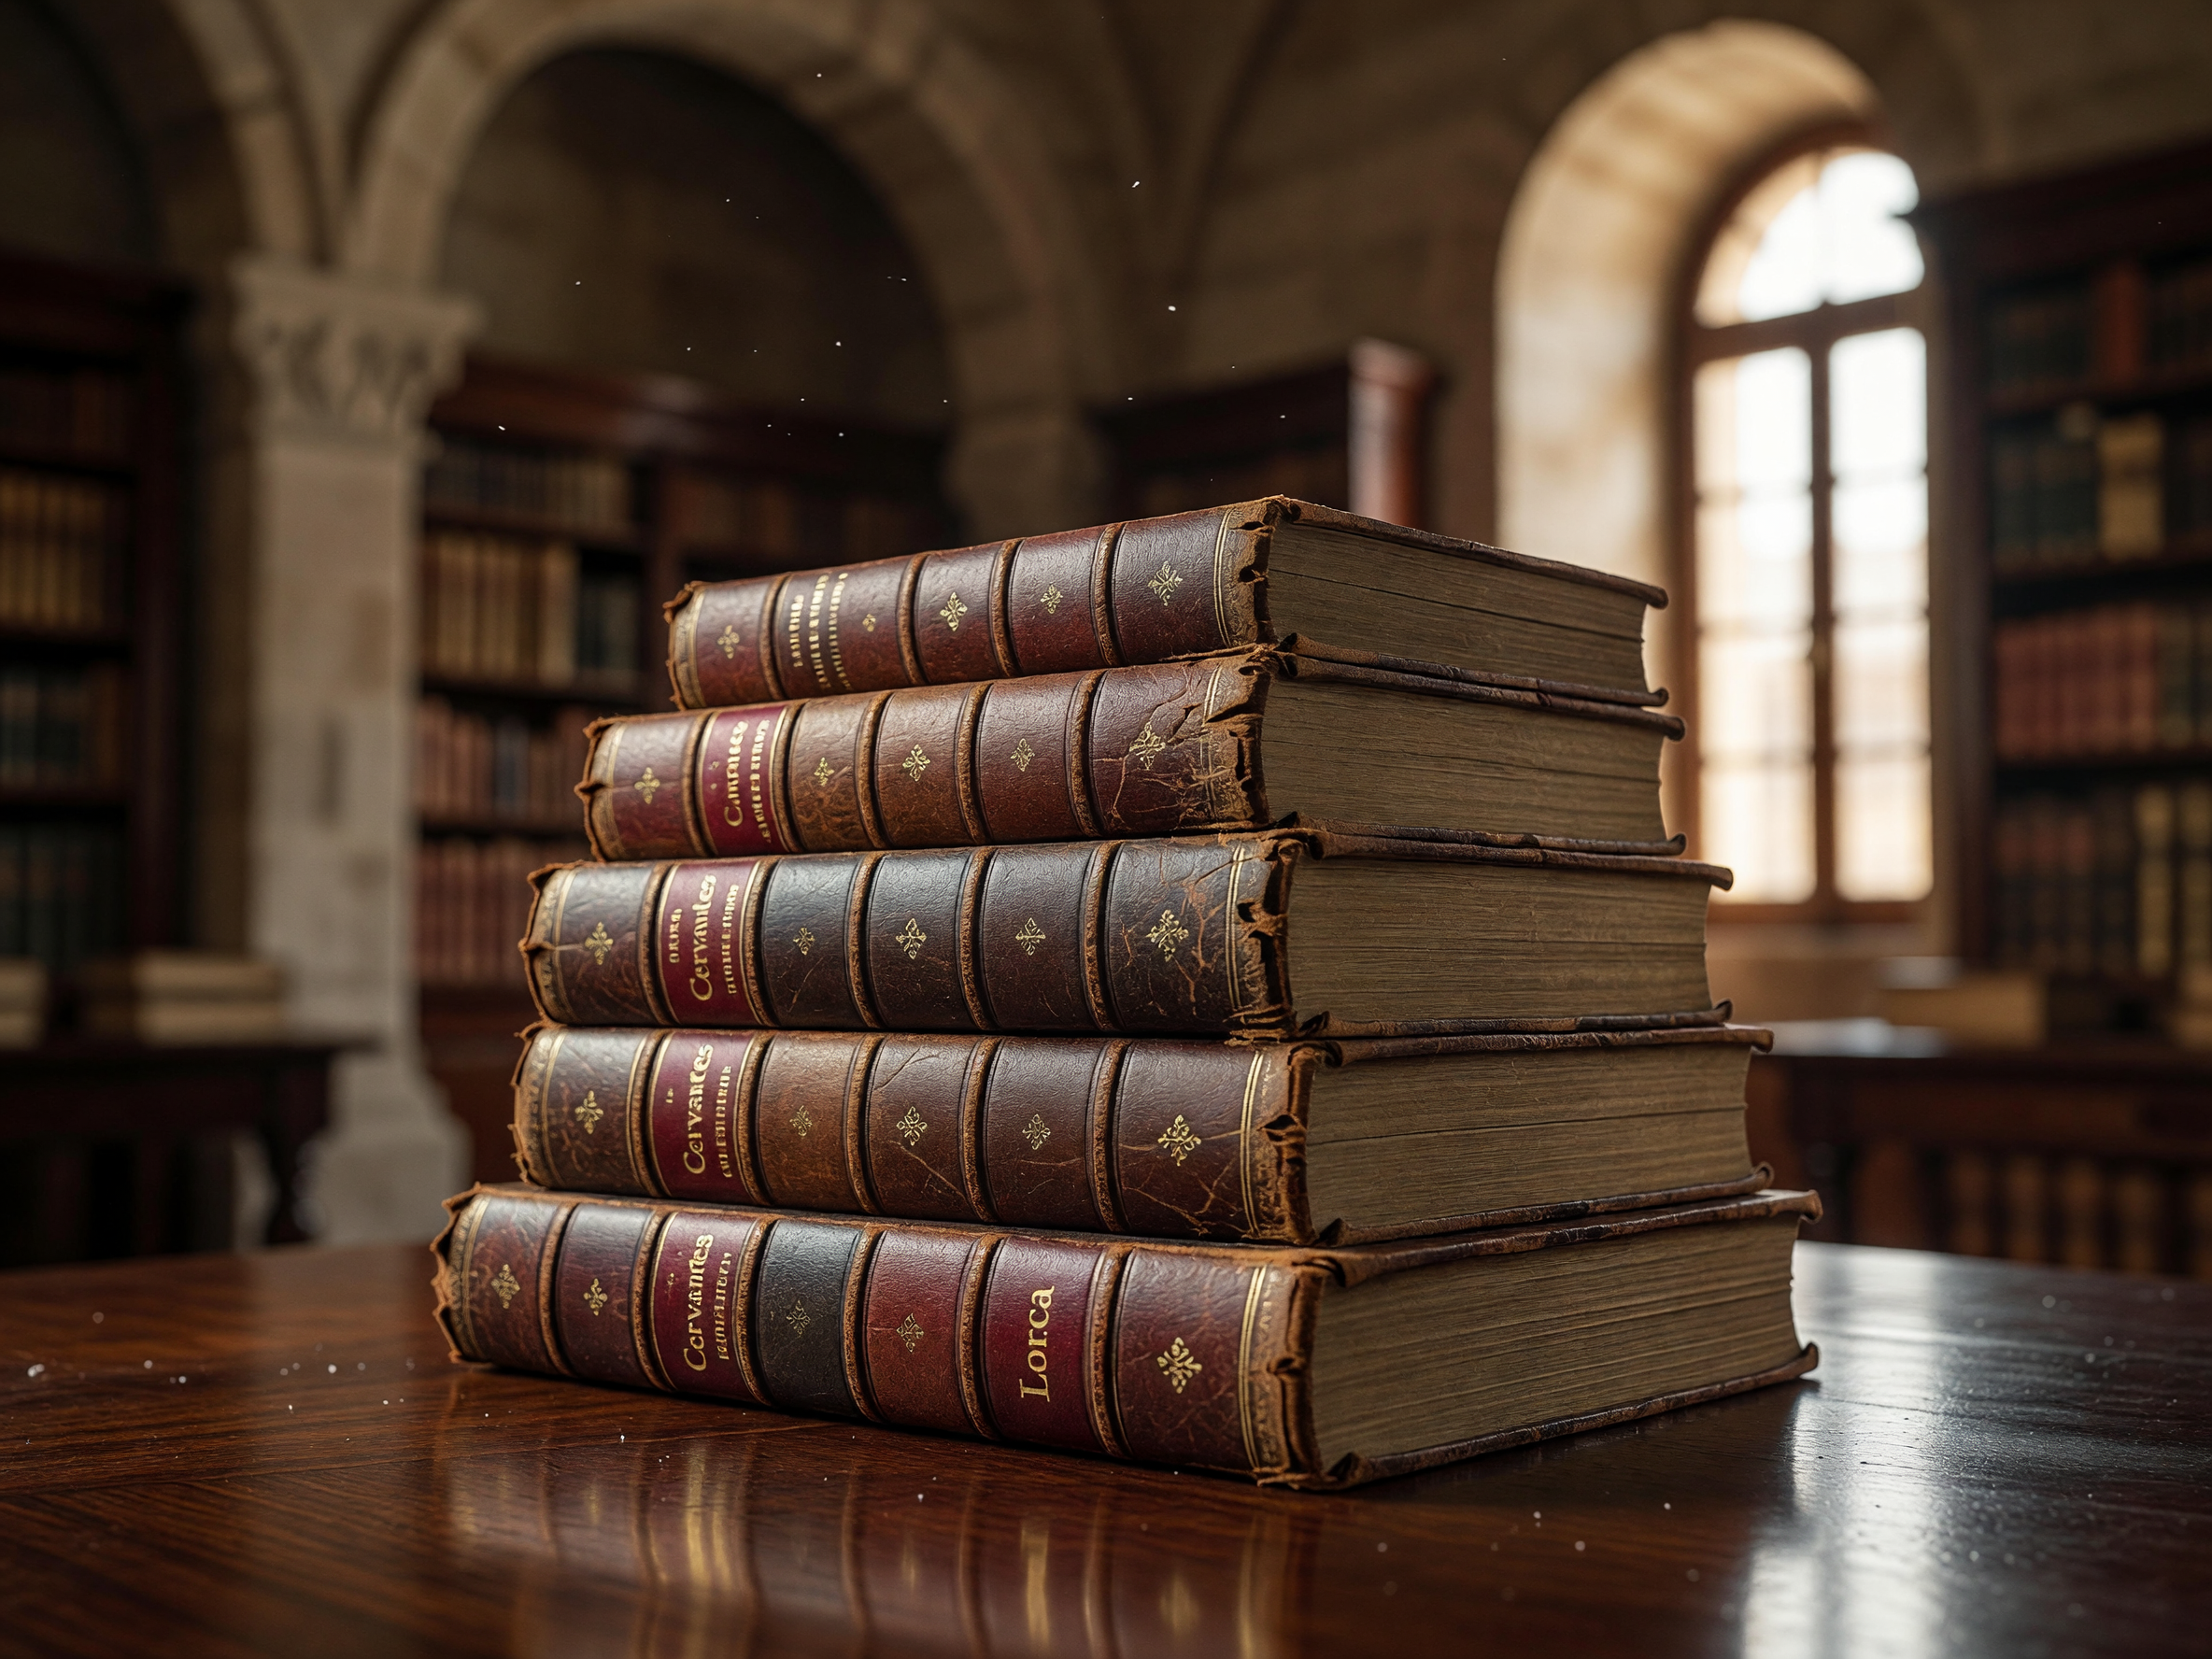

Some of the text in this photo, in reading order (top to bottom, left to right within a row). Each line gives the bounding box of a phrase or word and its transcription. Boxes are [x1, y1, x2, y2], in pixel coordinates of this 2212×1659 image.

[683, 1044, 714, 1174] Cervantes
[684, 1233, 714, 1371] Cervantes
[1019, 1285, 1055, 1402] Lorca
